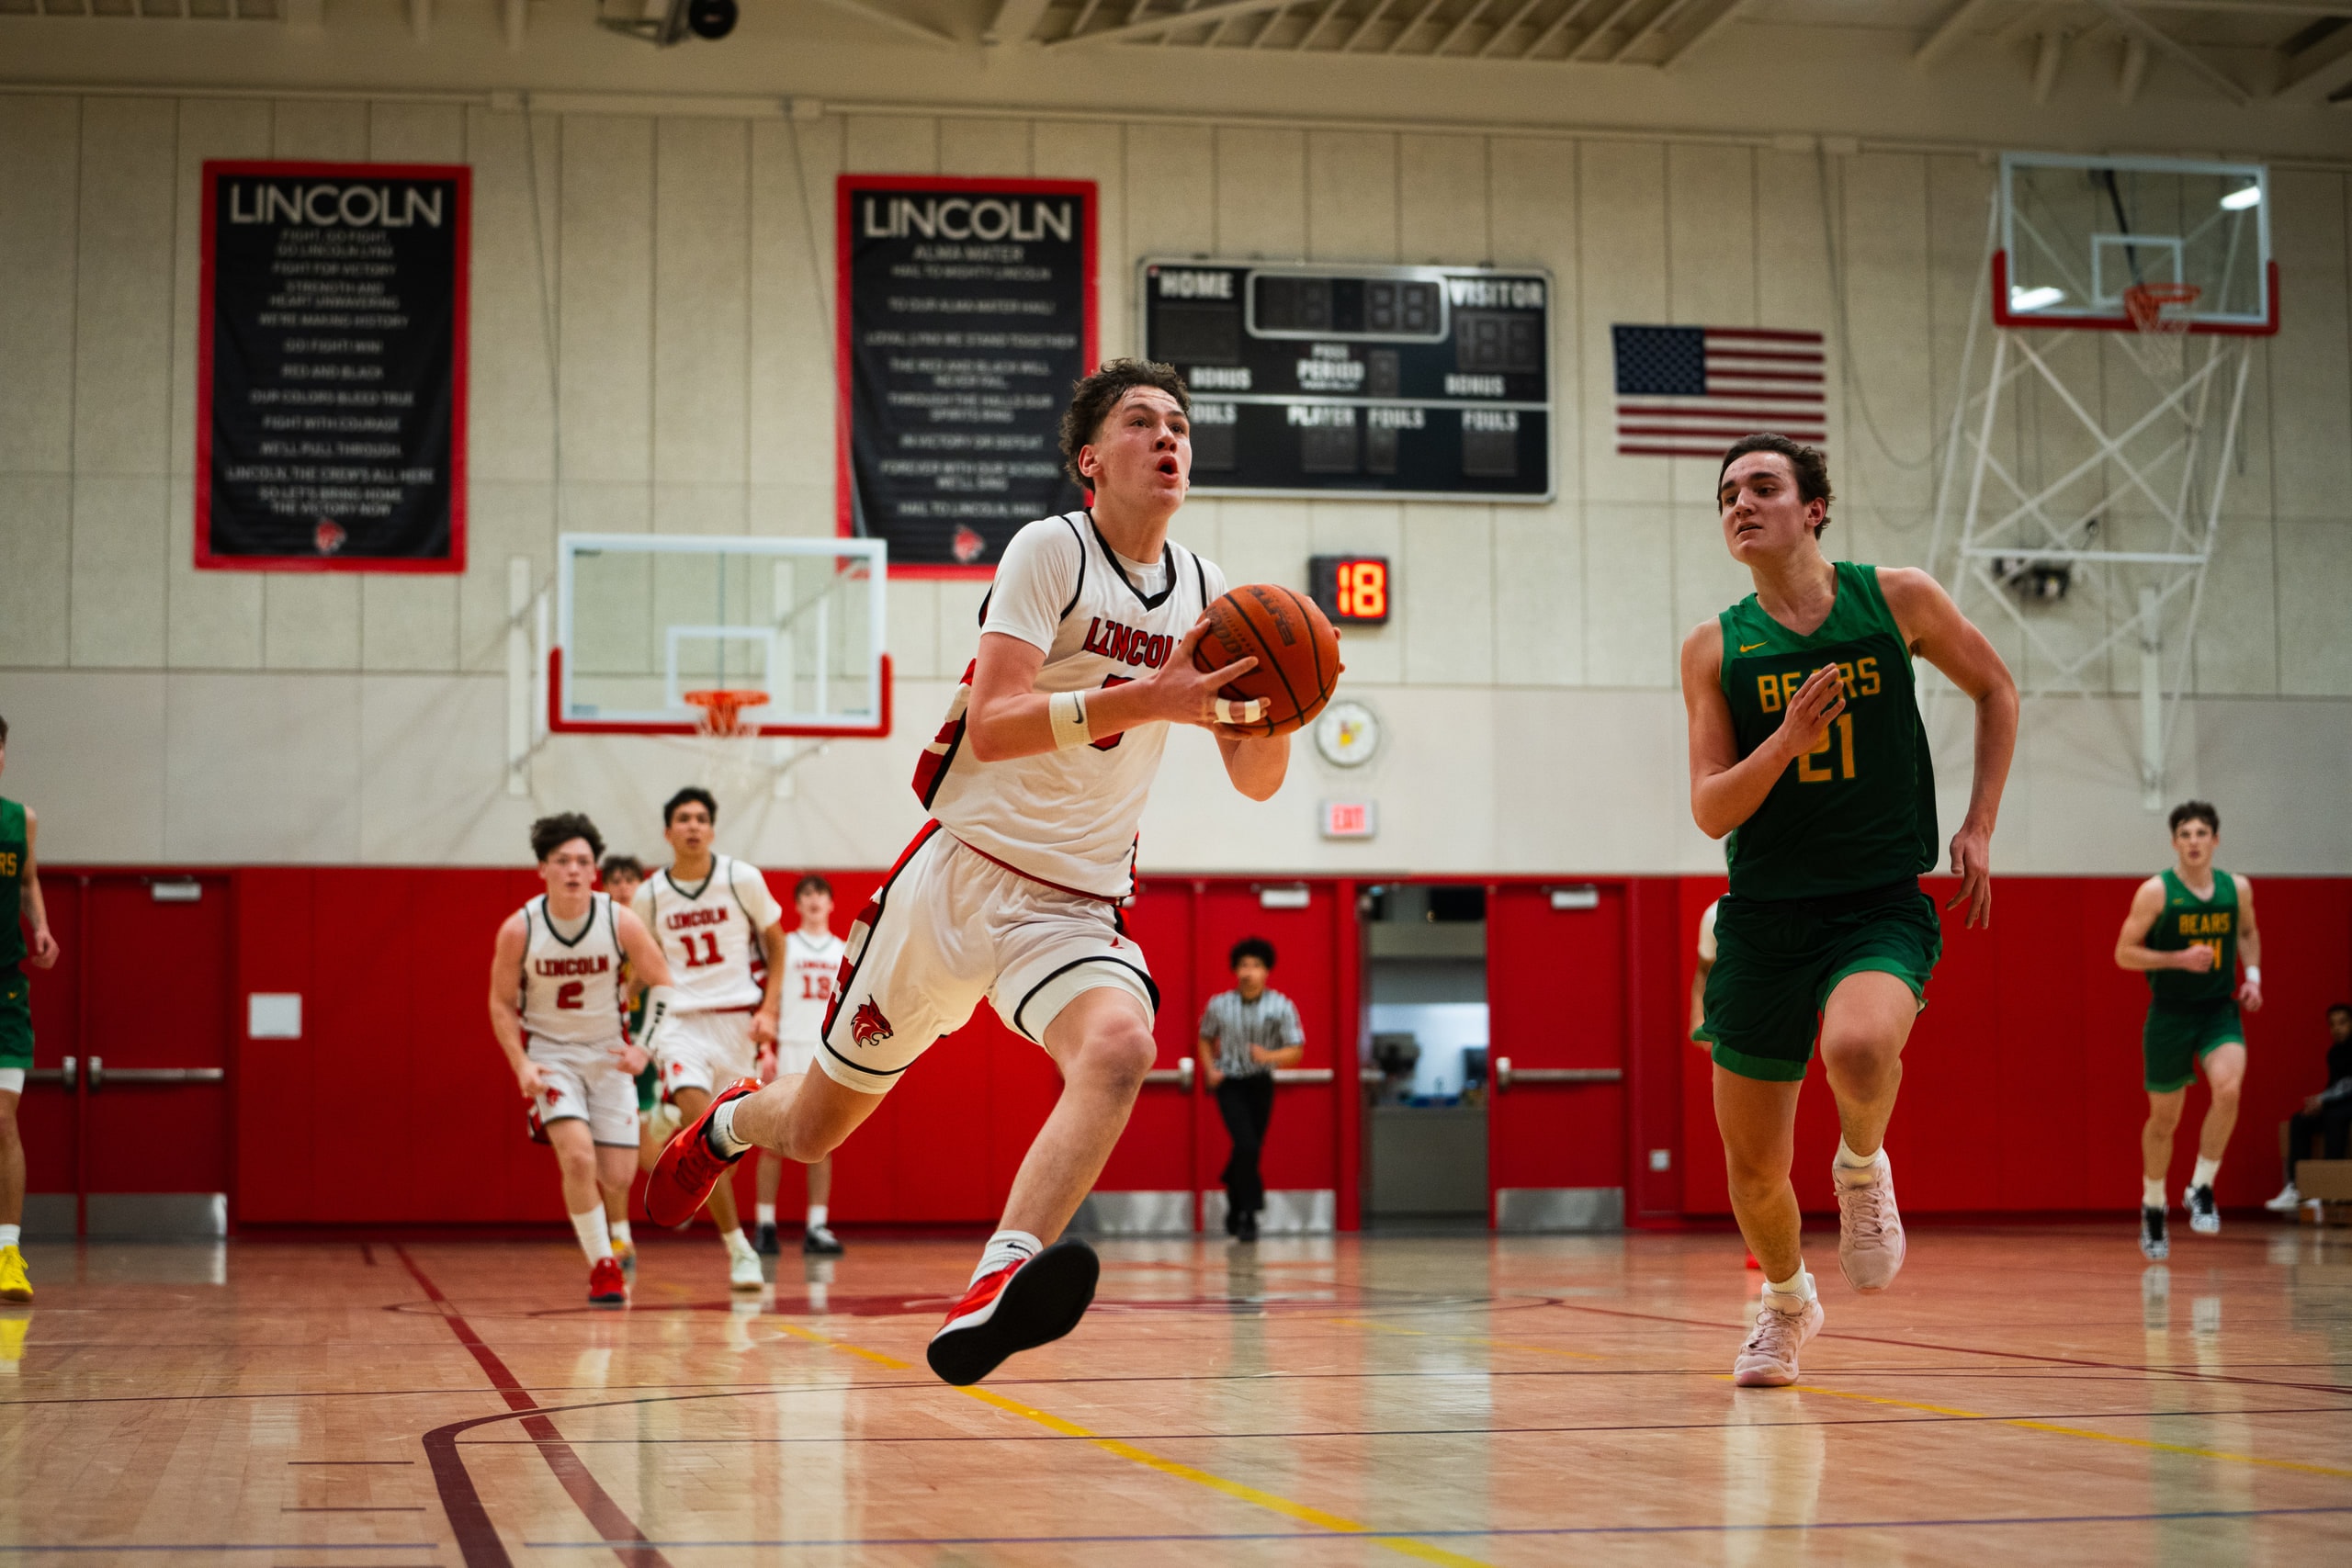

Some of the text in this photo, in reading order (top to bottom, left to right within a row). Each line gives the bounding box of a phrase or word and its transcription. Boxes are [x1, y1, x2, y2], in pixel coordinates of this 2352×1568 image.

[232, 184, 442, 227] LINCOLN
[864, 197, 1073, 243] LINCOLN
[1160, 273, 1232, 298] HOME
[1450, 281, 1544, 307] VISITOR
[280, 364, 384, 379] RED AND BLACK
[1191, 368, 1250, 388] BONUS
[1297, 361, 1363, 380] PERIOD
[1445, 376, 1505, 396] BONUS
[263, 416, 401, 433] FIGHT WITH COURAGE
[1191, 405, 1237, 423] OULS
[1289, 407, 1425, 429] PLAYER FOULS
[1463, 412, 1519, 431] FOULS
[1338, 561, 1387, 617] 18
[1081, 616, 1182, 671] LINCOL
[665, 907, 730, 931] LINCOLN
[2178, 912, 2232, 935] BEARS
[680, 931, 725, 968] 11
[2189, 938, 2222, 970] 4
[536, 955, 609, 976] LINCOLN
[557, 981, 584, 1010] 2
